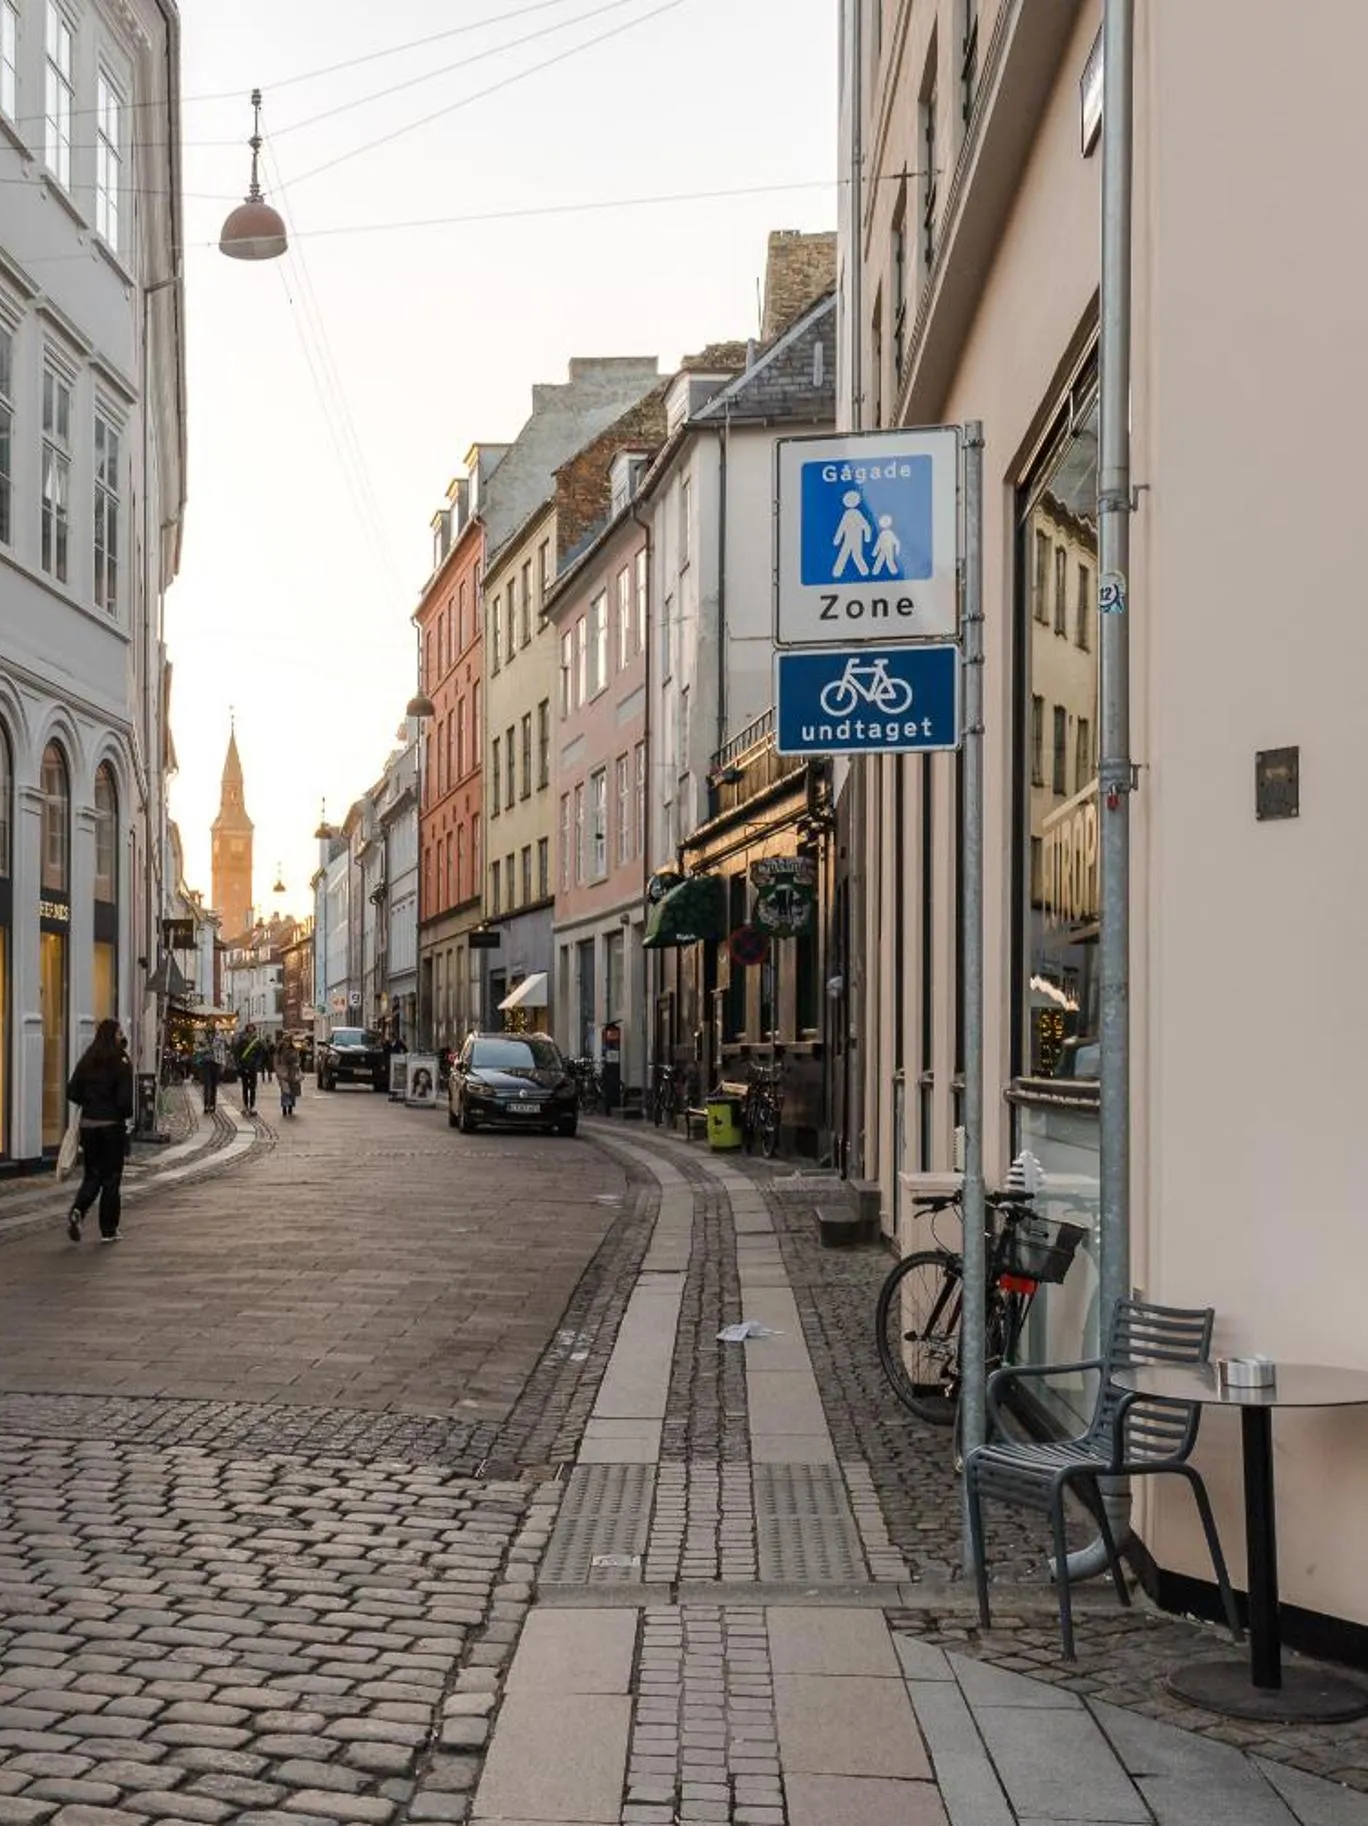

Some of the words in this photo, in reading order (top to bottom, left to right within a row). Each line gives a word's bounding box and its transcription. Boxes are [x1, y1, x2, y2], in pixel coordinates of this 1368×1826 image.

[822, 462, 912, 483] Gågade
[819, 594, 915, 621] Zone
[801, 716, 933, 741] undtaget
